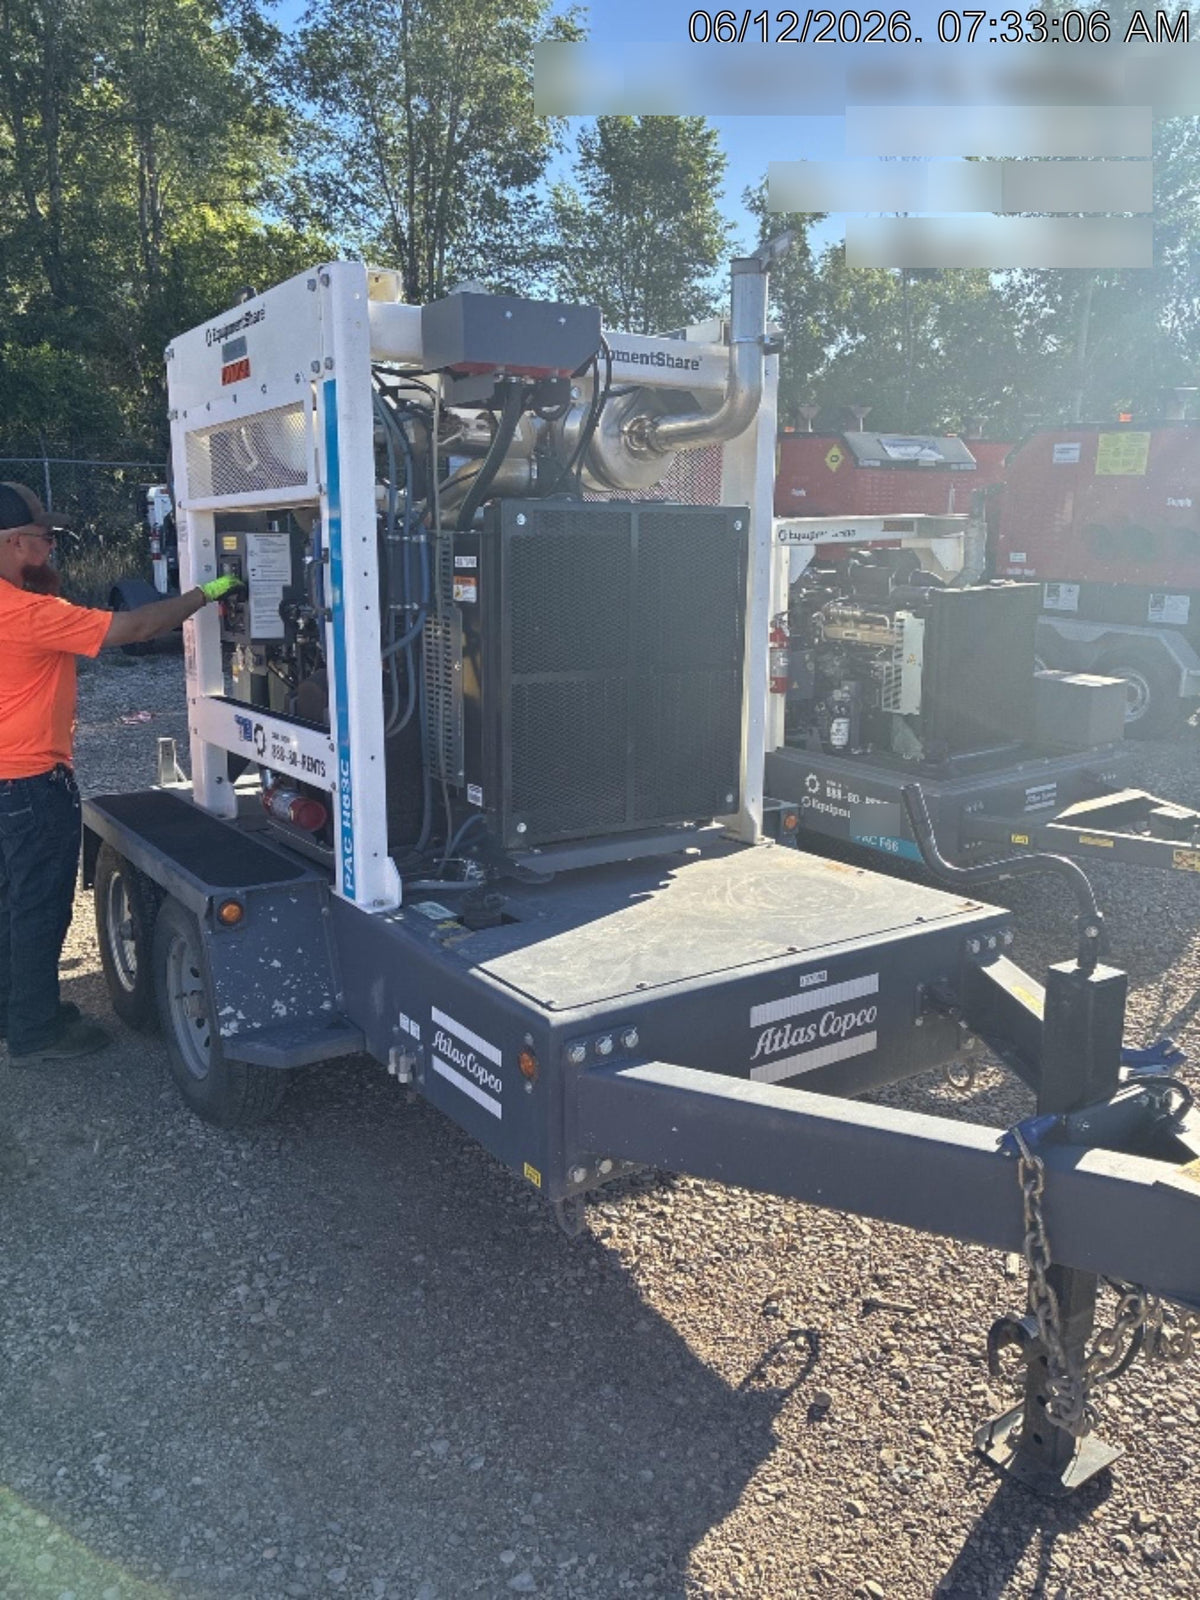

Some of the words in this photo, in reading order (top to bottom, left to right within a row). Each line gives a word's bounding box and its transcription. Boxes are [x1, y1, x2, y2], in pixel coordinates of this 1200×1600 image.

[343, 839, 355, 891] PAC
[750, 1023, 817, 1061] Atlas
[819, 1005, 878, 1038] Copco
[432, 1030, 467, 1067] Atlas
[466, 1053, 503, 1094] Copco
